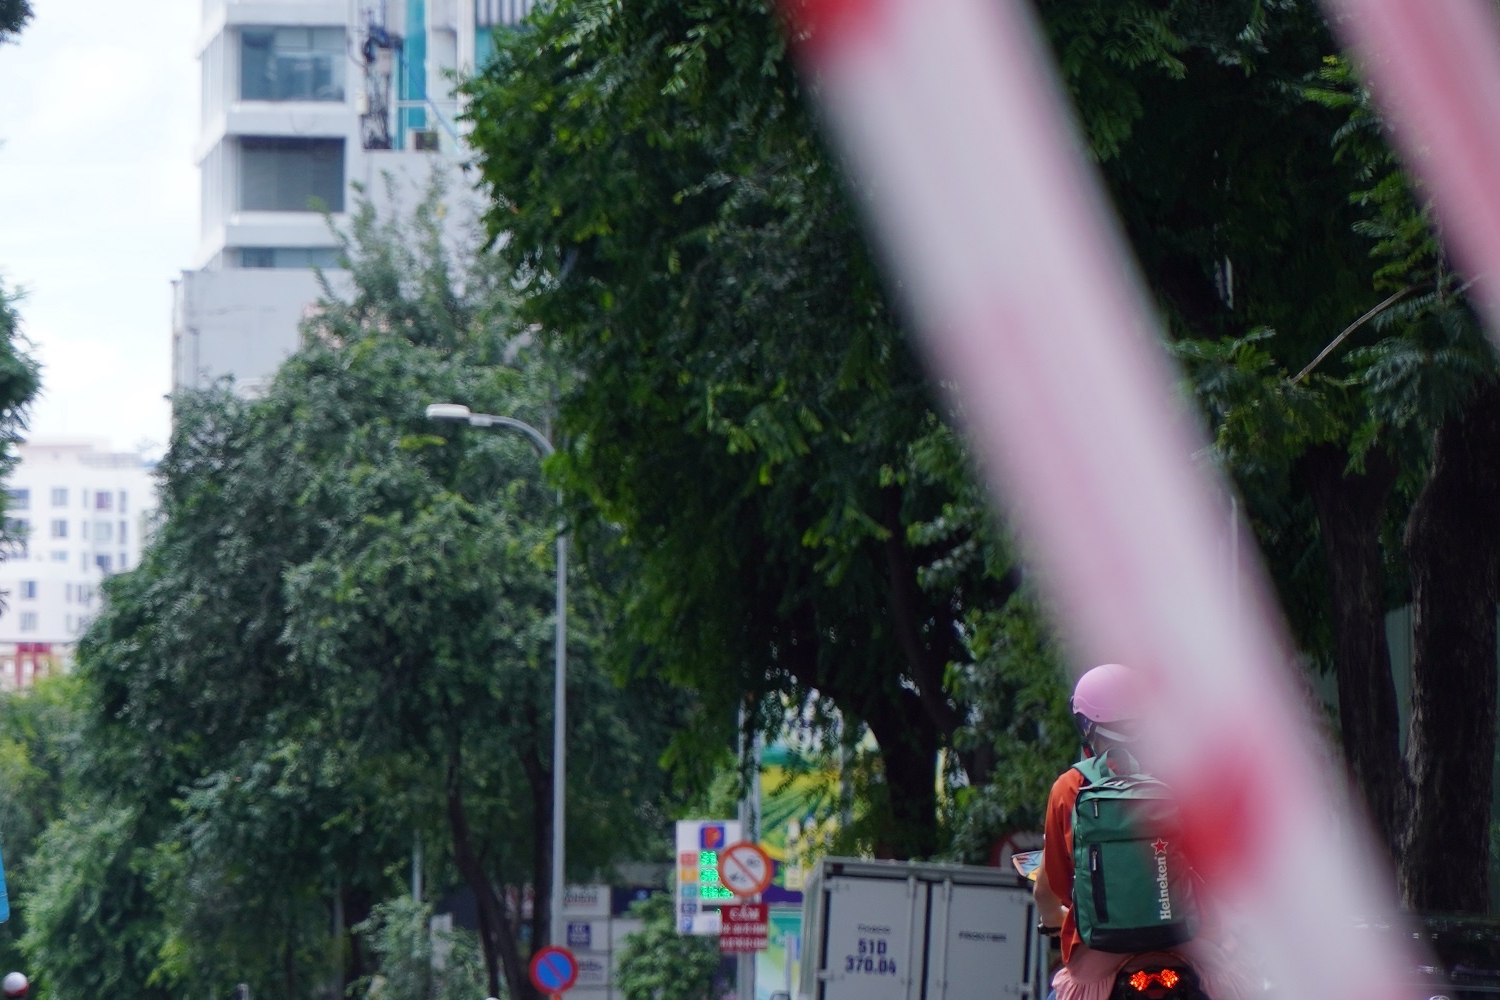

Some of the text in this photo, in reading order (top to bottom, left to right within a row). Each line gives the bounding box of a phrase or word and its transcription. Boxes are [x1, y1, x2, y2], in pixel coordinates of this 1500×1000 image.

[1157, 857, 1172, 920] Heineken
[857, 938, 887, 955] 51D
[845, 955, 896, 975] 370.04
